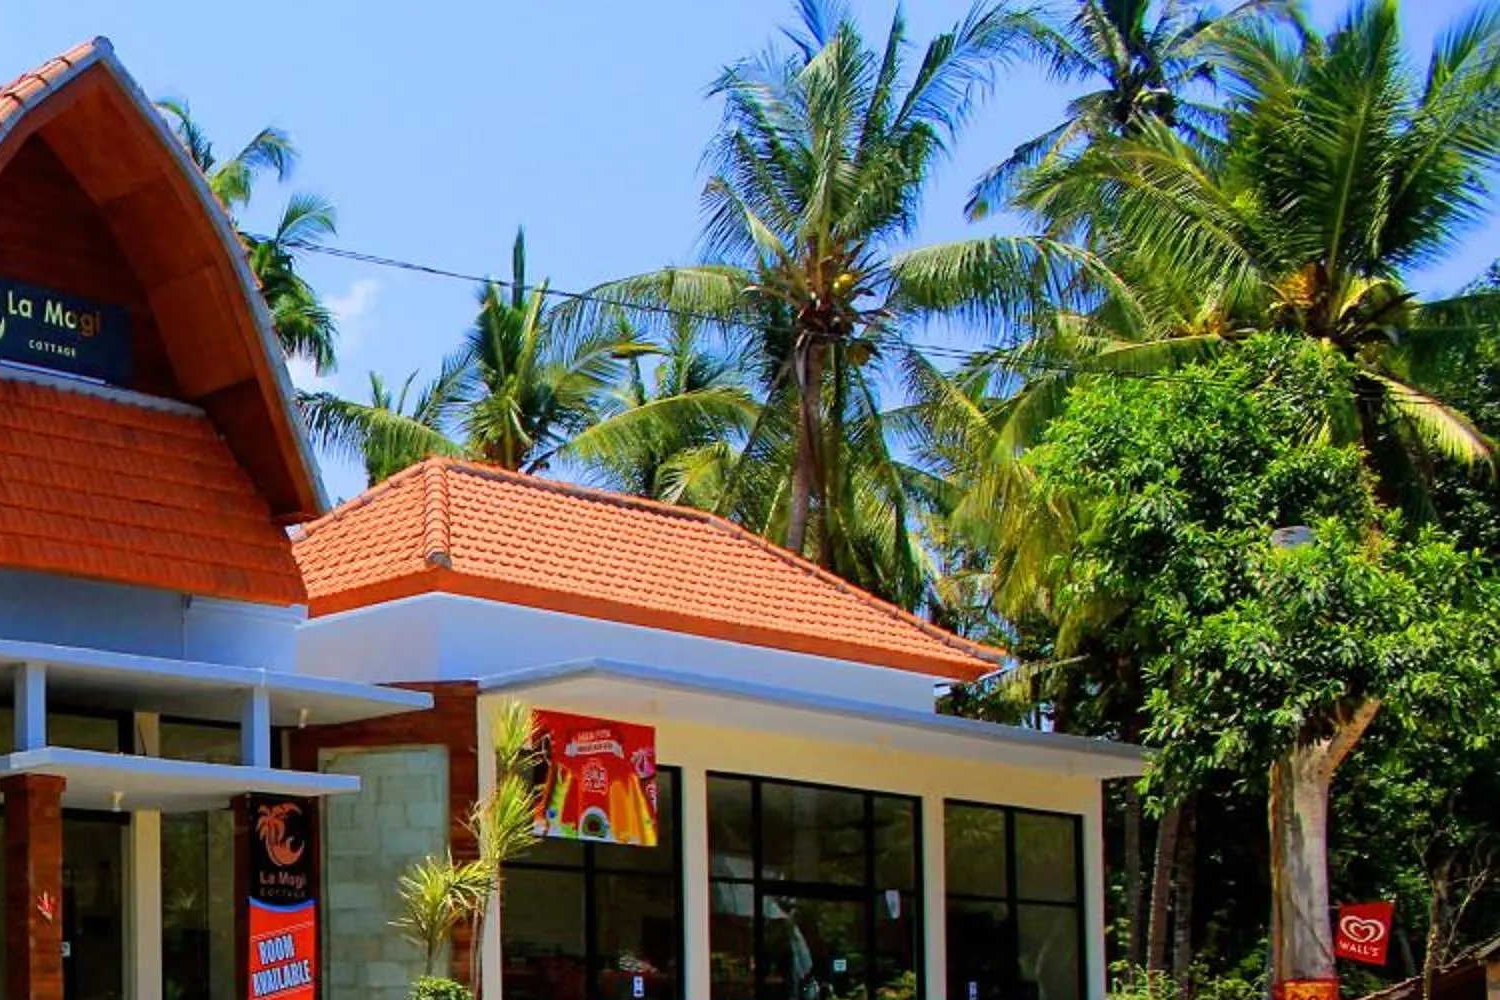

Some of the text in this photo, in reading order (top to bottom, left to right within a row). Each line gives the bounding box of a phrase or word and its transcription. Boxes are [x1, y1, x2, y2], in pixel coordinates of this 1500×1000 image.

[7, 290, 101, 337] La Mogi
[29, 340, 76, 357] COTTAGE
[259, 871, 276, 885] La
[259, 934, 294, 965] ROOM
[1339, 941, 1379, 957] WALL'S
[252, 960, 311, 996] AVAILABLE
